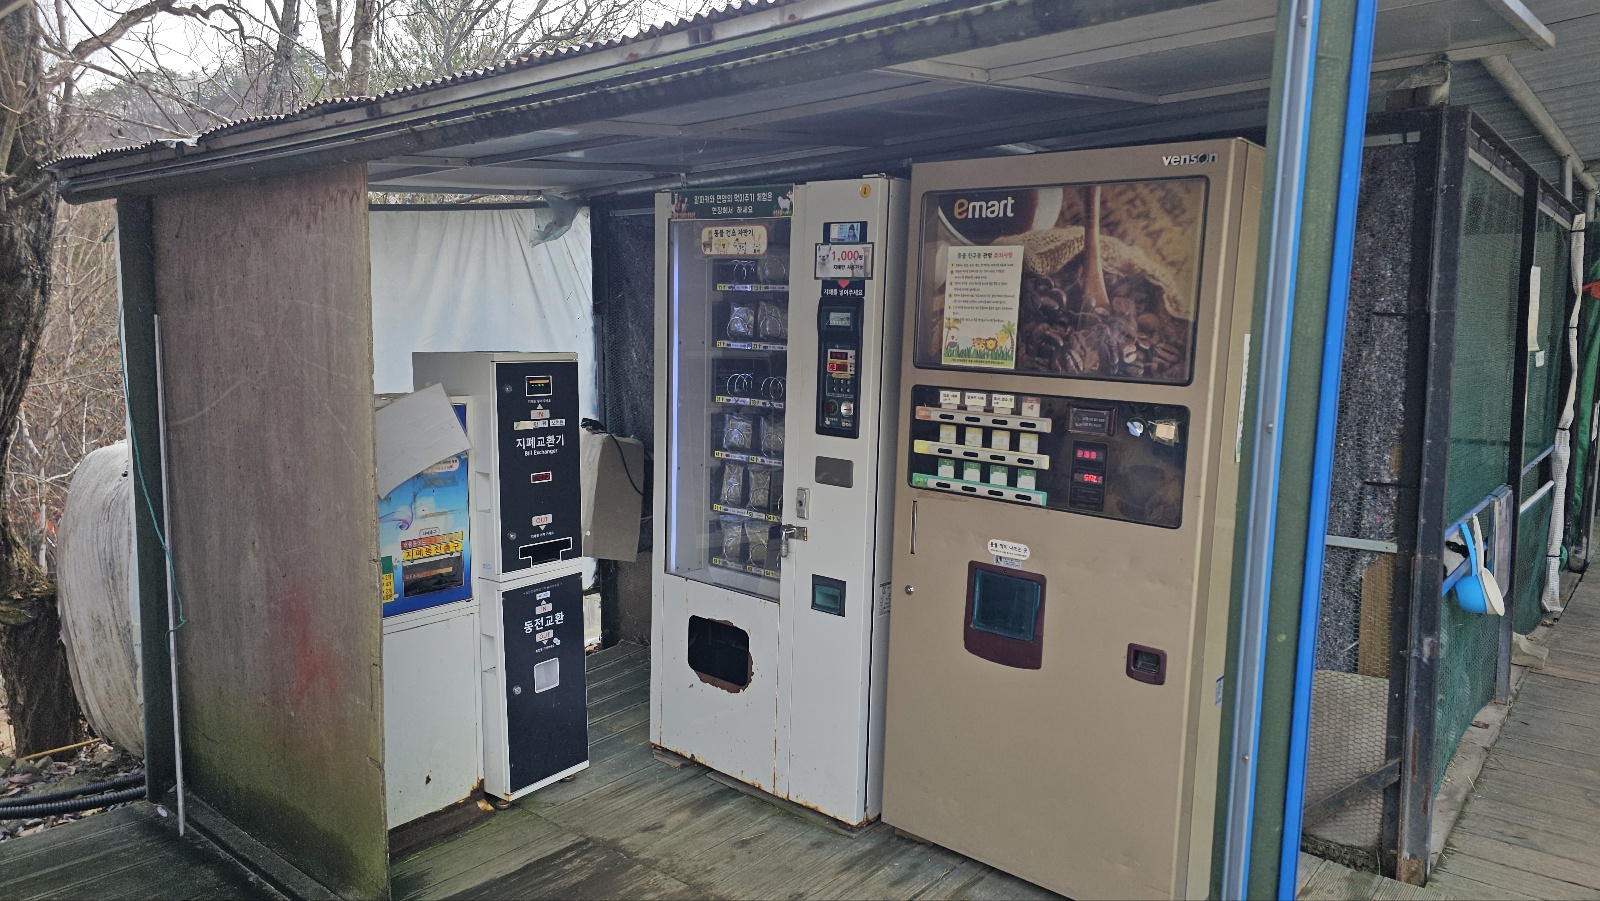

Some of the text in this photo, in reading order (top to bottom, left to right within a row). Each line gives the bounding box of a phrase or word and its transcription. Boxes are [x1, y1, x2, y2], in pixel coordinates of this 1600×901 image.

[1162, 152, 1218, 167] venson
[953, 196, 1015, 220] emart
[516, 434, 565, 450] 지폐교환기
[533, 448, 558, 456] Exchanger
[535, 516, 548, 524] OUT
[523, 611, 565, 634] 동전교환
[539, 631, 551, 640] OUT
